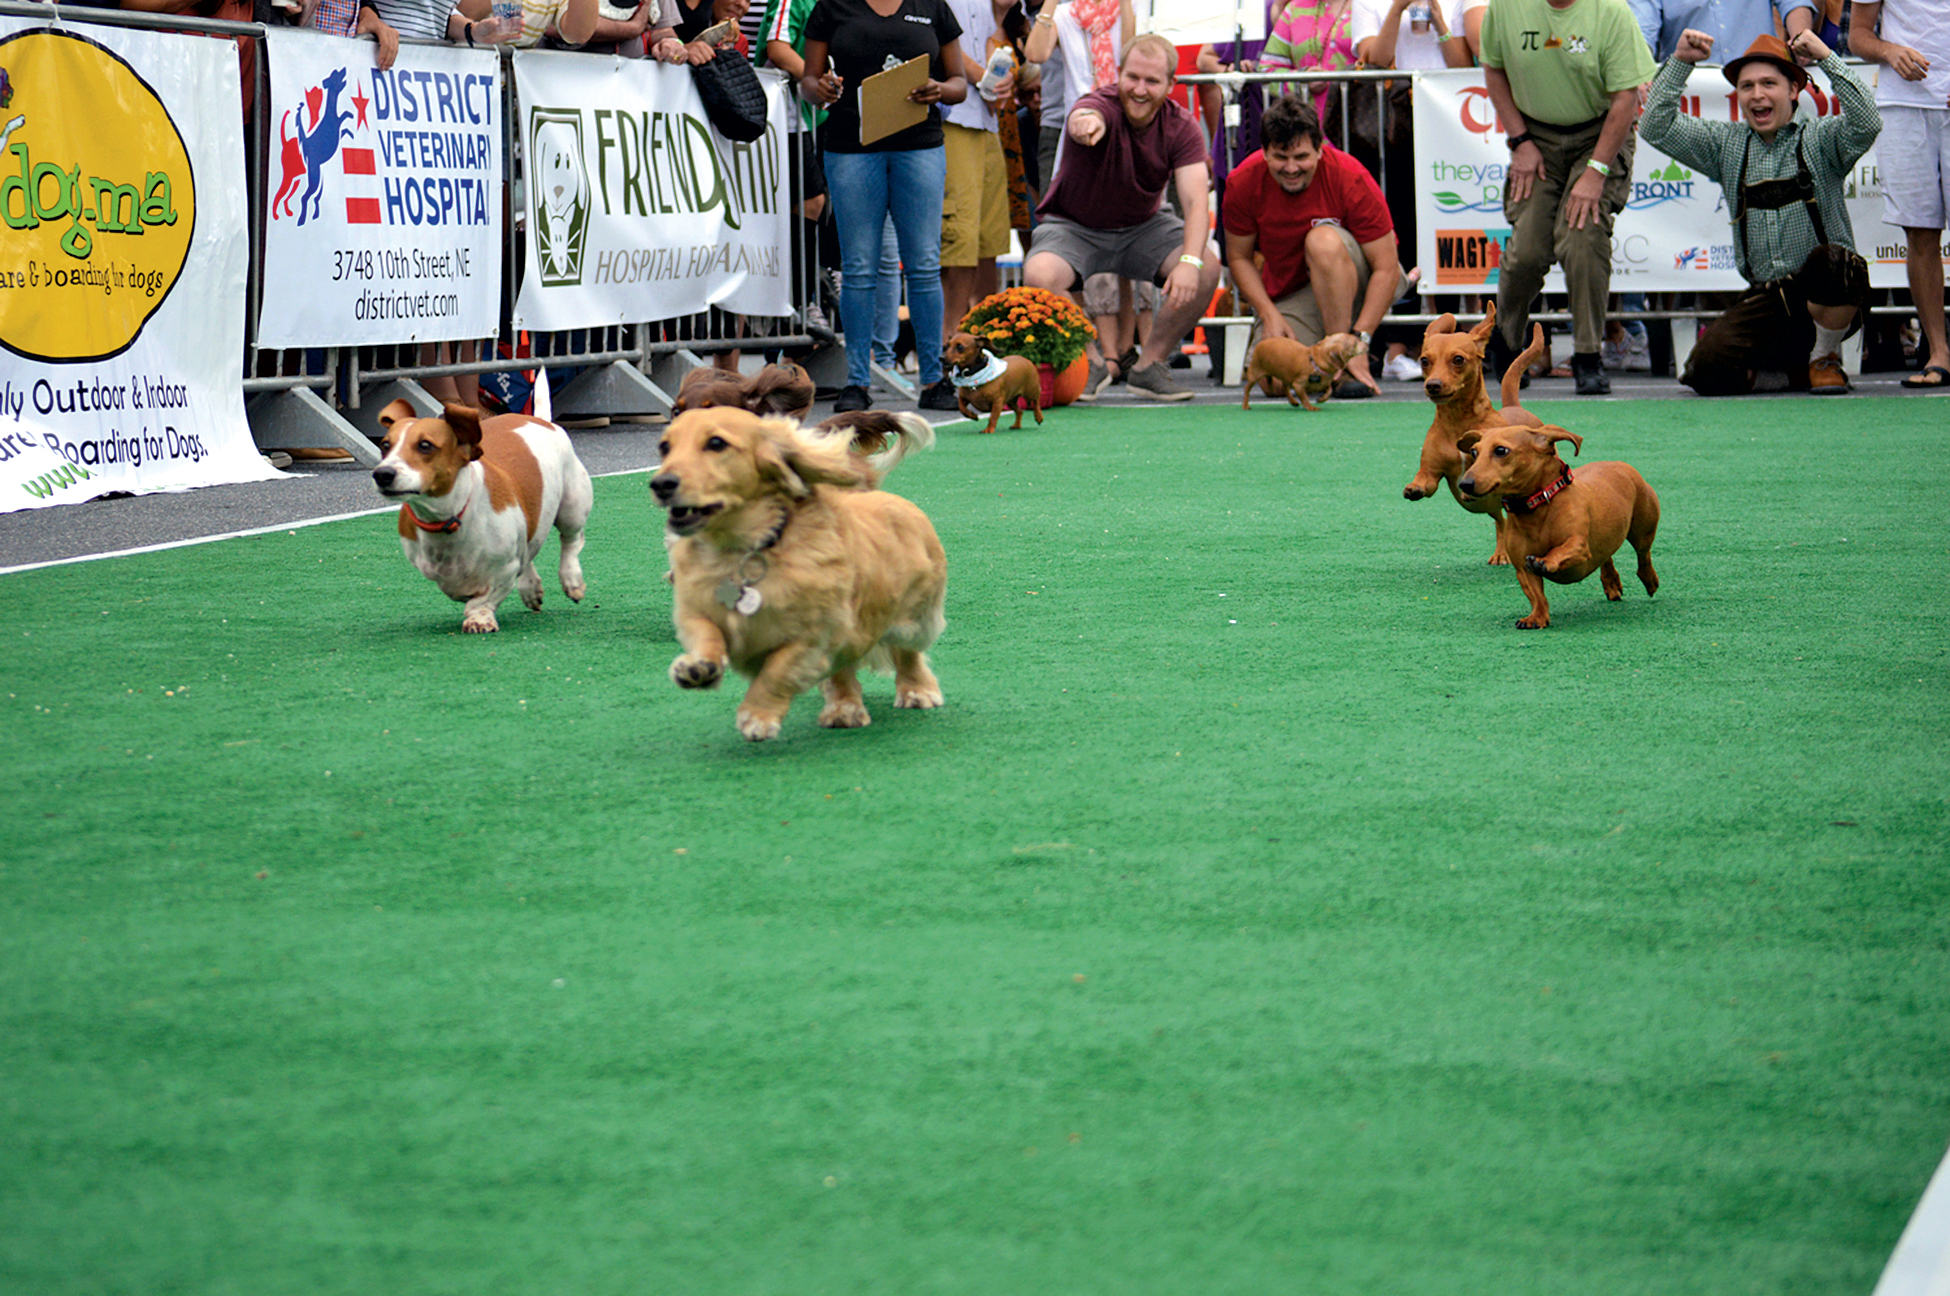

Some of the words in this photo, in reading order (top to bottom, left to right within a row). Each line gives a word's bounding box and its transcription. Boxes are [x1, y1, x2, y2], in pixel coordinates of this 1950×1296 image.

[371, 67, 493, 125] DISTRICT
[1431, 160, 1509, 186] theya
[385, 177, 490, 226] HOSPITAL
[332, 250, 374, 281] 3748
[377, 247, 410, 279] 10th
[412, 248, 454, 282] Street,
[455, 248, 471, 277] NE
[595, 247, 682, 284] HOSPITAL
[1710, 245, 1734, 254] DIST
[29, 260, 39, 287] &
[129, 263, 163, 297] dogs
[355, 288, 459, 321] districtvet.com
[32, 376, 126, 415] Outdoor
[131, 375, 143, 409] &
[143, 375, 188, 409] Indoor
[143, 426, 164, 461] for
